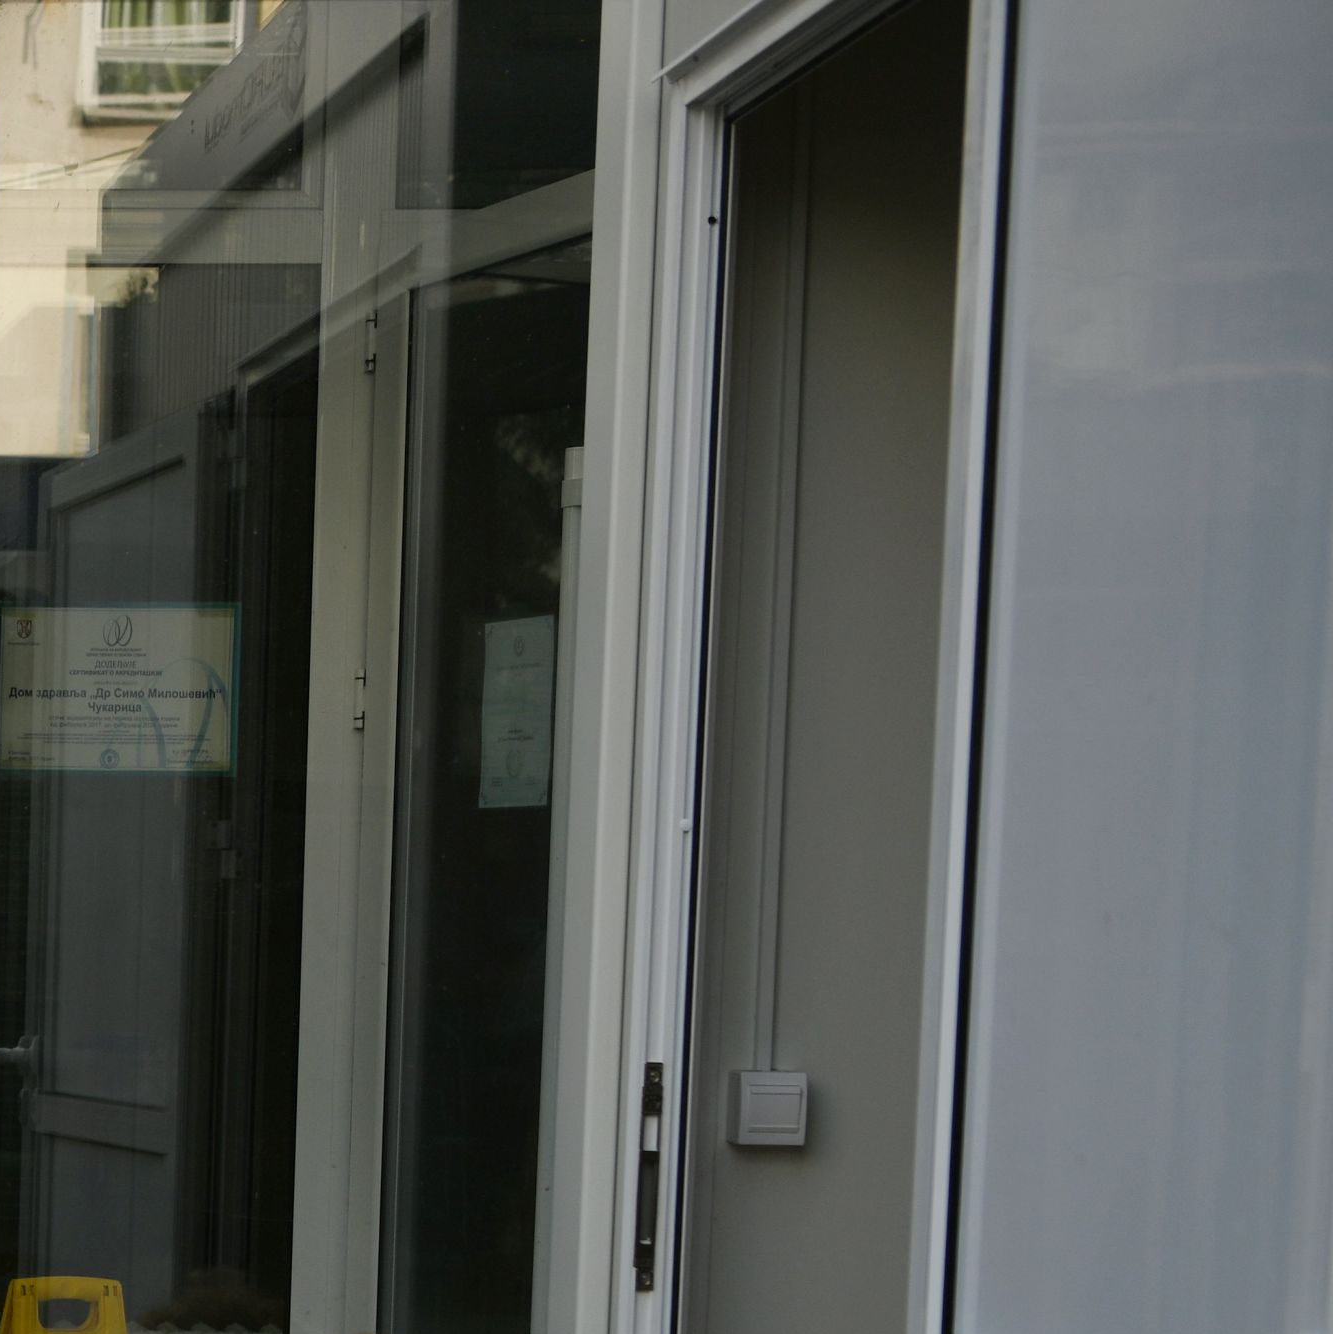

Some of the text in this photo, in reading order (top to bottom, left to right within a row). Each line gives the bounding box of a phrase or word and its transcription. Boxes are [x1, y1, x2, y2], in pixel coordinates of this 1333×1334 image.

[9, 687, 33, 699] Дом
[36, 689, 87, 700] здравља
[114, 688, 145, 699] Симо
[88, 701, 142, 714] Чукарица
